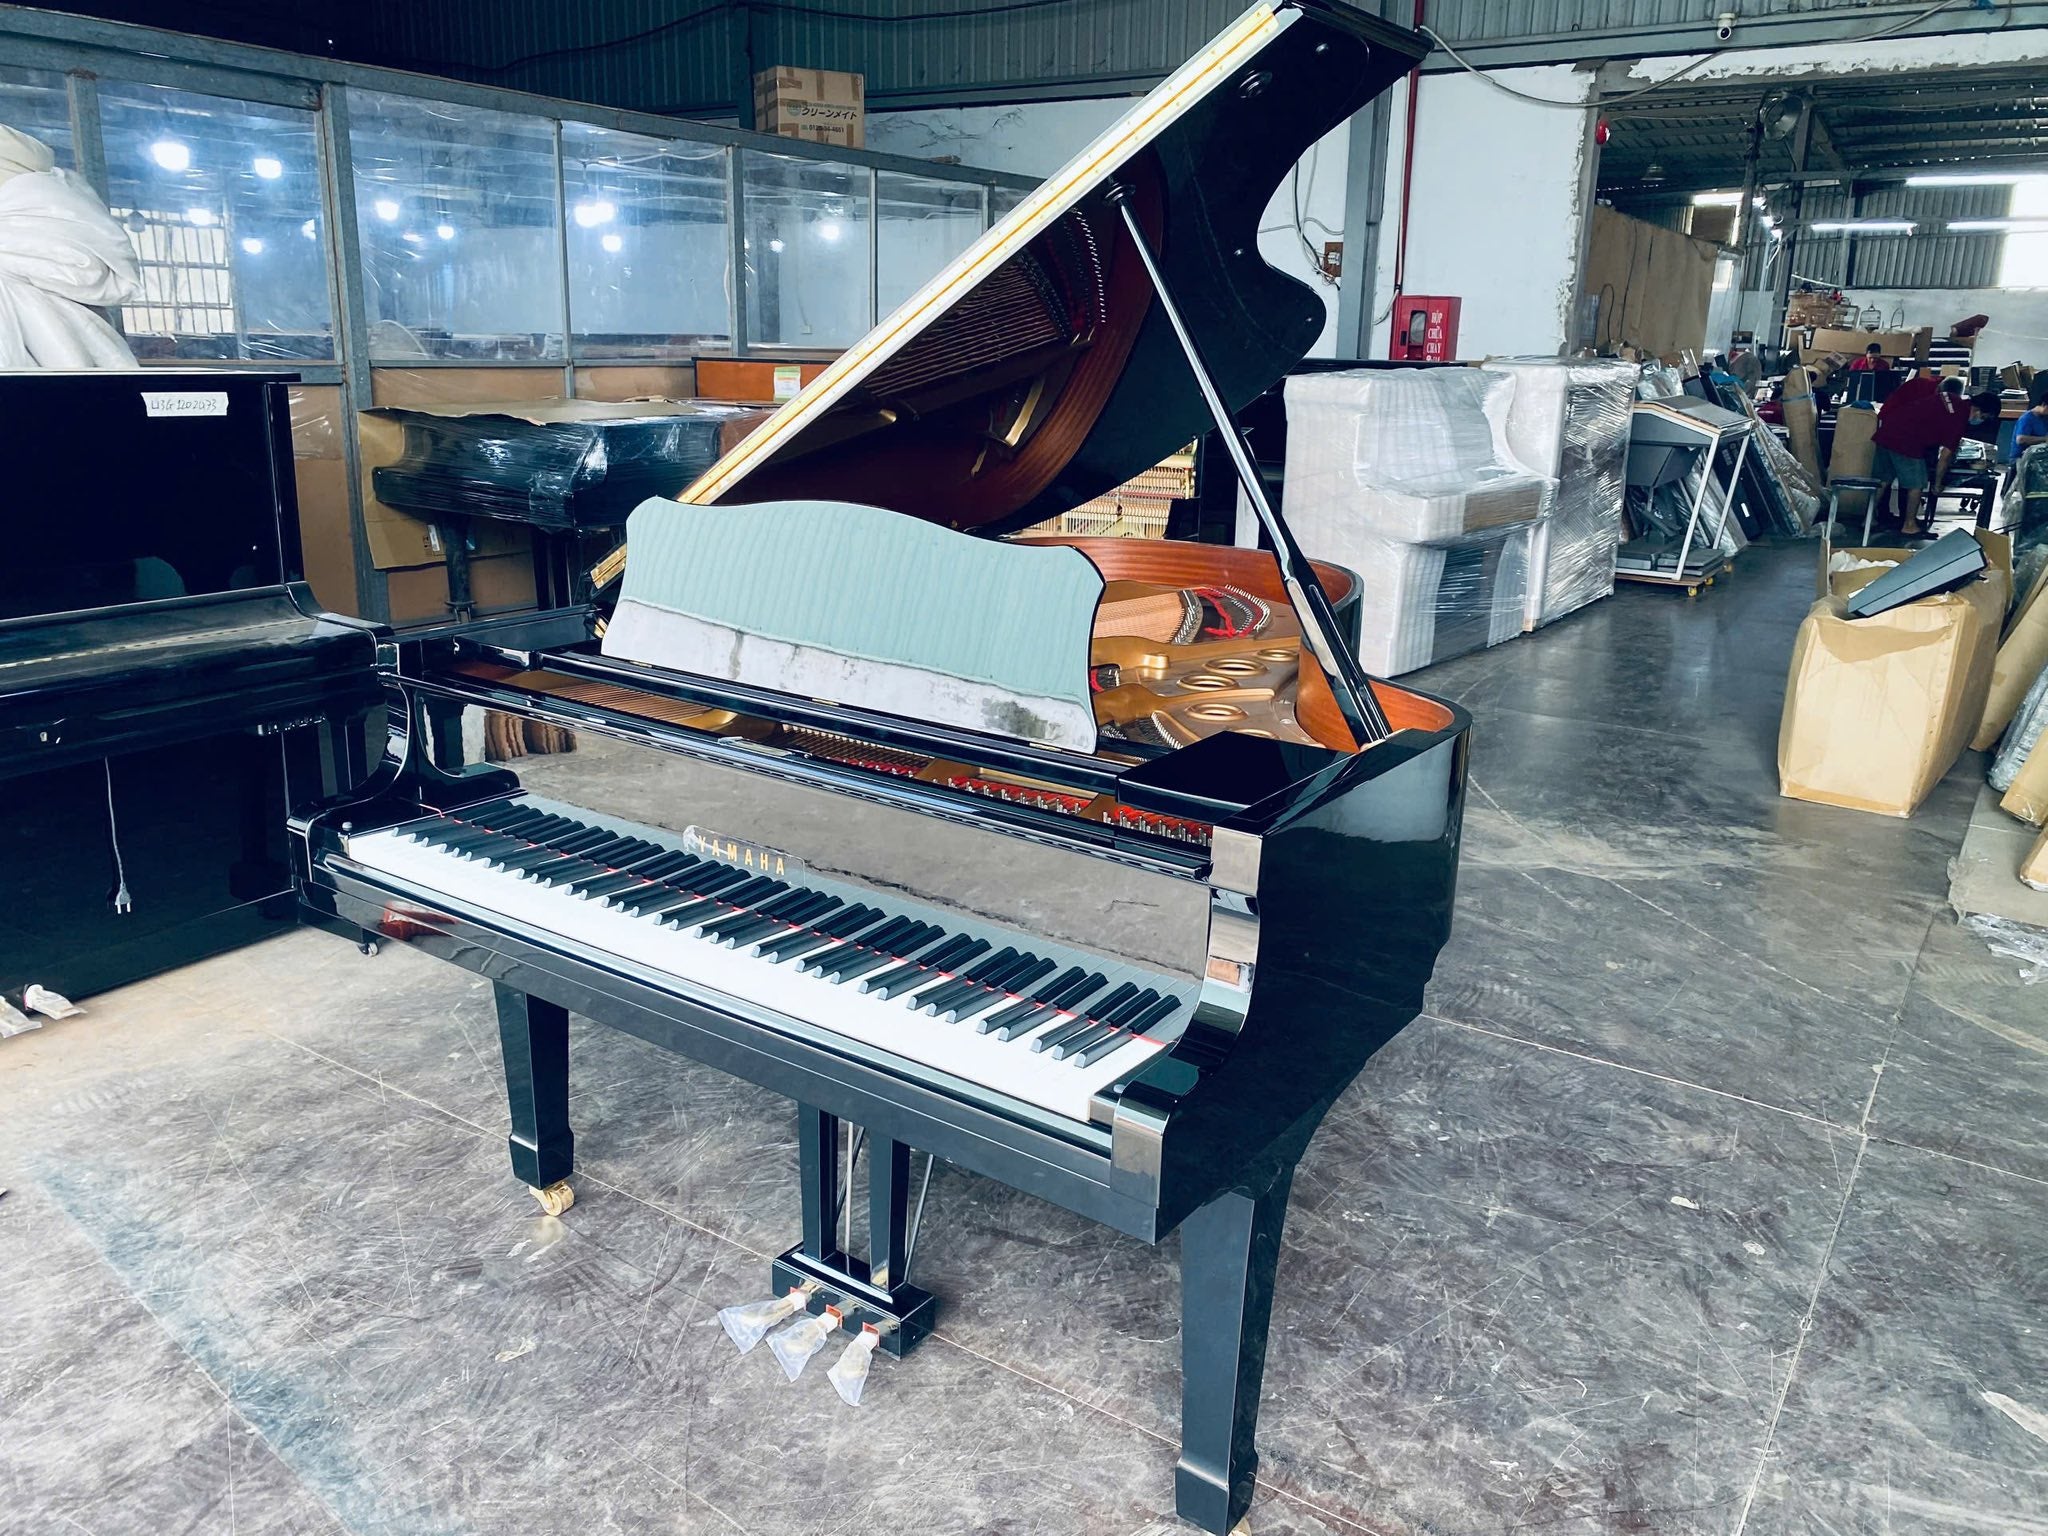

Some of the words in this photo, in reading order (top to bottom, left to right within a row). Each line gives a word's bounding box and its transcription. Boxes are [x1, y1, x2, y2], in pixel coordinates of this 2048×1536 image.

[801, 107, 857, 120] クリーンメイト
[698, 834, 785, 876] YAMAHA
